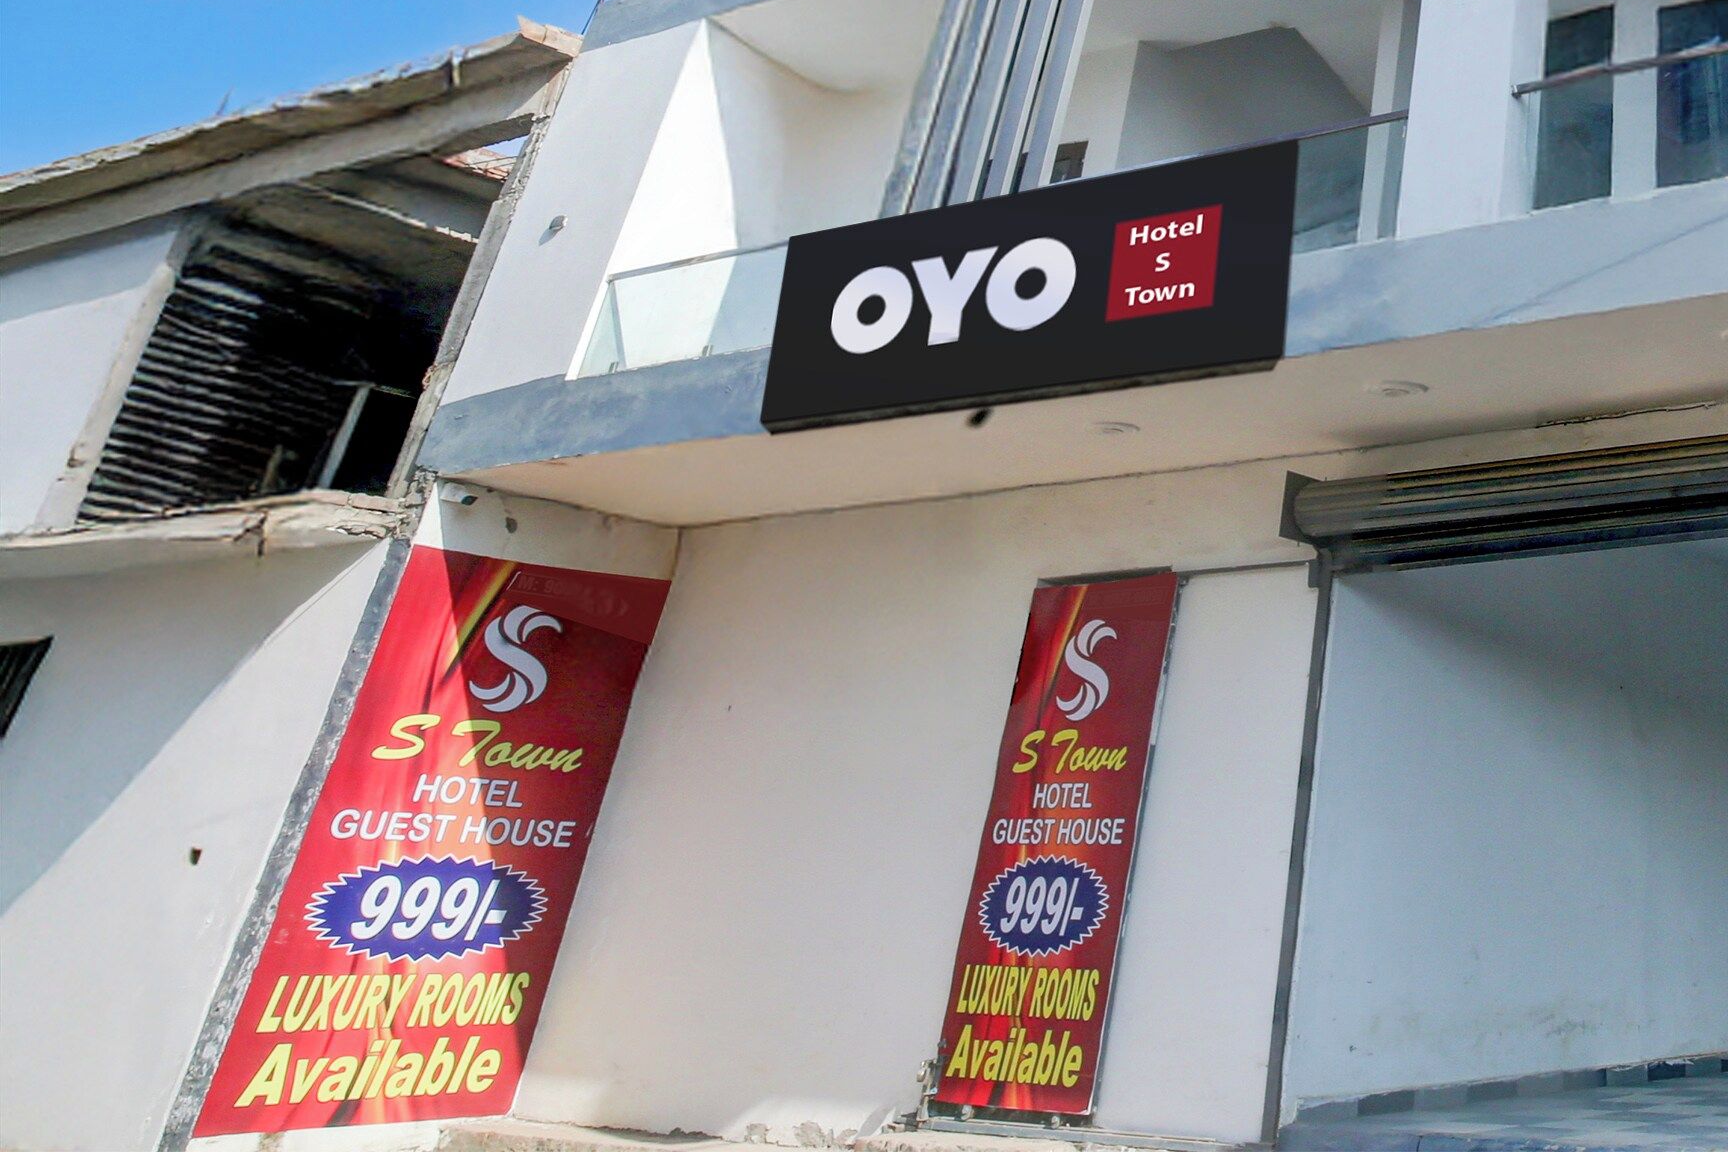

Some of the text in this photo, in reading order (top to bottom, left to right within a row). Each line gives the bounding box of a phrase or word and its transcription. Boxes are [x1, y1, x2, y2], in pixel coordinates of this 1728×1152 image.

[1129, 214, 1204, 247] Hotel
[1154, 251, 1171, 273] S
[830, 237, 1077, 354] OYO
[1124, 280, 1196, 307] Town
[371, 713, 582, 773] S Town
[1012, 728, 1129, 774] S Town
[412, 773, 524, 809] HOTEL
[1032, 783, 1093, 810] HOTEL
[329, 809, 577, 849] GUEST HOUSE
[992, 817, 1126, 846] GUEST HOUSE
[255, 970, 531, 1035] LUXURY ROOMS
[956, 964, 1101, 1022] LUXURY ROOMS
[233, 1035, 503, 1108] Available
[945, 1024, 1084, 1088] Available
